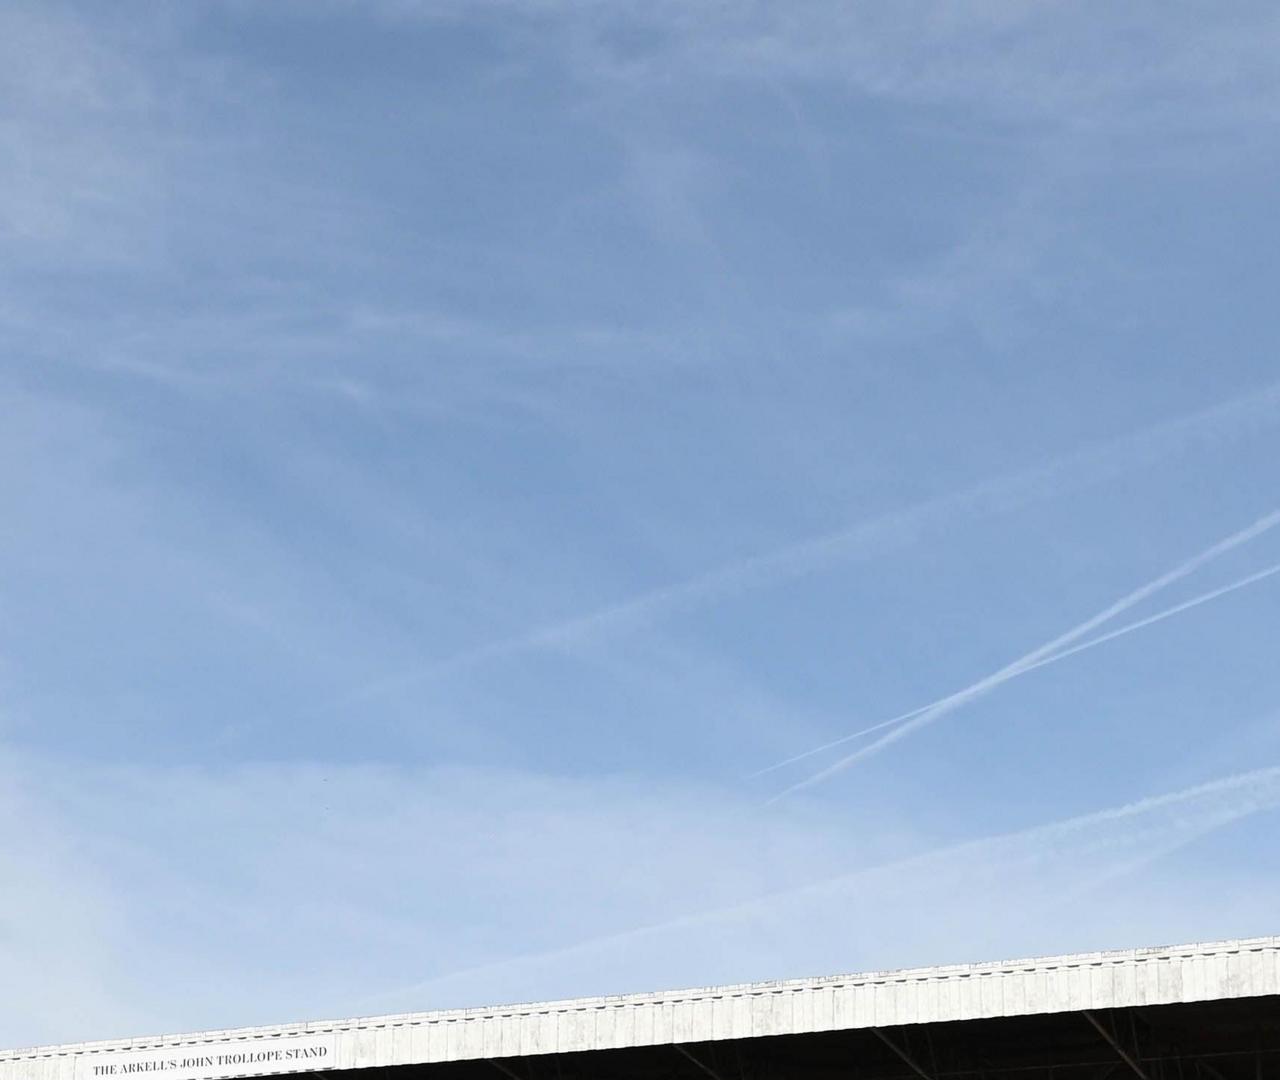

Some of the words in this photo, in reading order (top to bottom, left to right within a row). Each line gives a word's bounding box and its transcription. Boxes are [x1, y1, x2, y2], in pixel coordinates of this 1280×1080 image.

[94, 1065, 117, 1076] THE
[120, 1060, 177, 1074] ARKELL'S
[179, 1057, 213, 1069] JOHN
[216, 1051, 283, 1066] TROLLOPE
[285, 1047, 328, 1060] STAND
